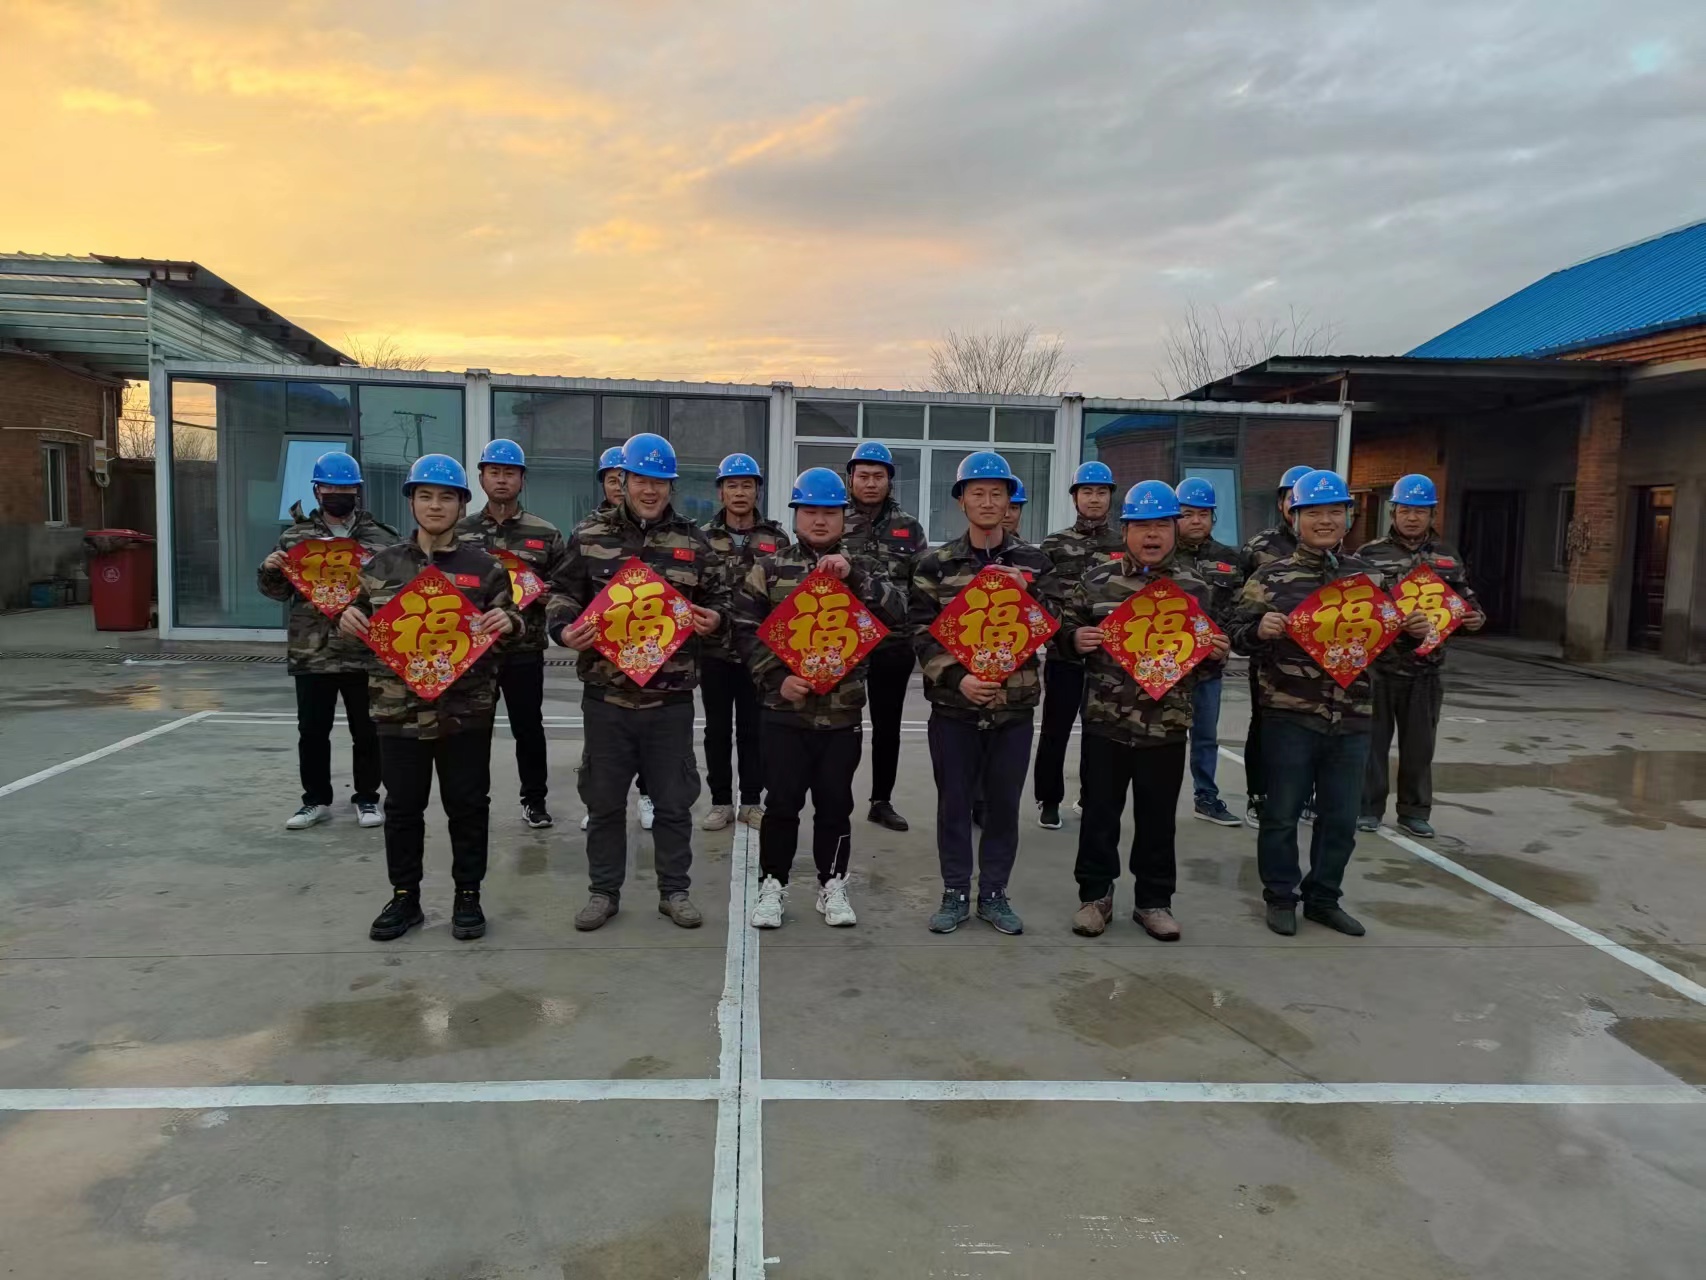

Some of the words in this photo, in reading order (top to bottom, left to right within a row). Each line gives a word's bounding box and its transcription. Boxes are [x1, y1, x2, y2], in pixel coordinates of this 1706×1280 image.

[300, 541, 359, 589] 福
[391, 590, 470, 664] 福
[603, 582, 675, 648] 福
[788, 587, 858, 658] 福
[959, 586, 1029, 654] 福
[1123, 596, 1195, 664] 福
[1312, 585, 1383, 651] 福
